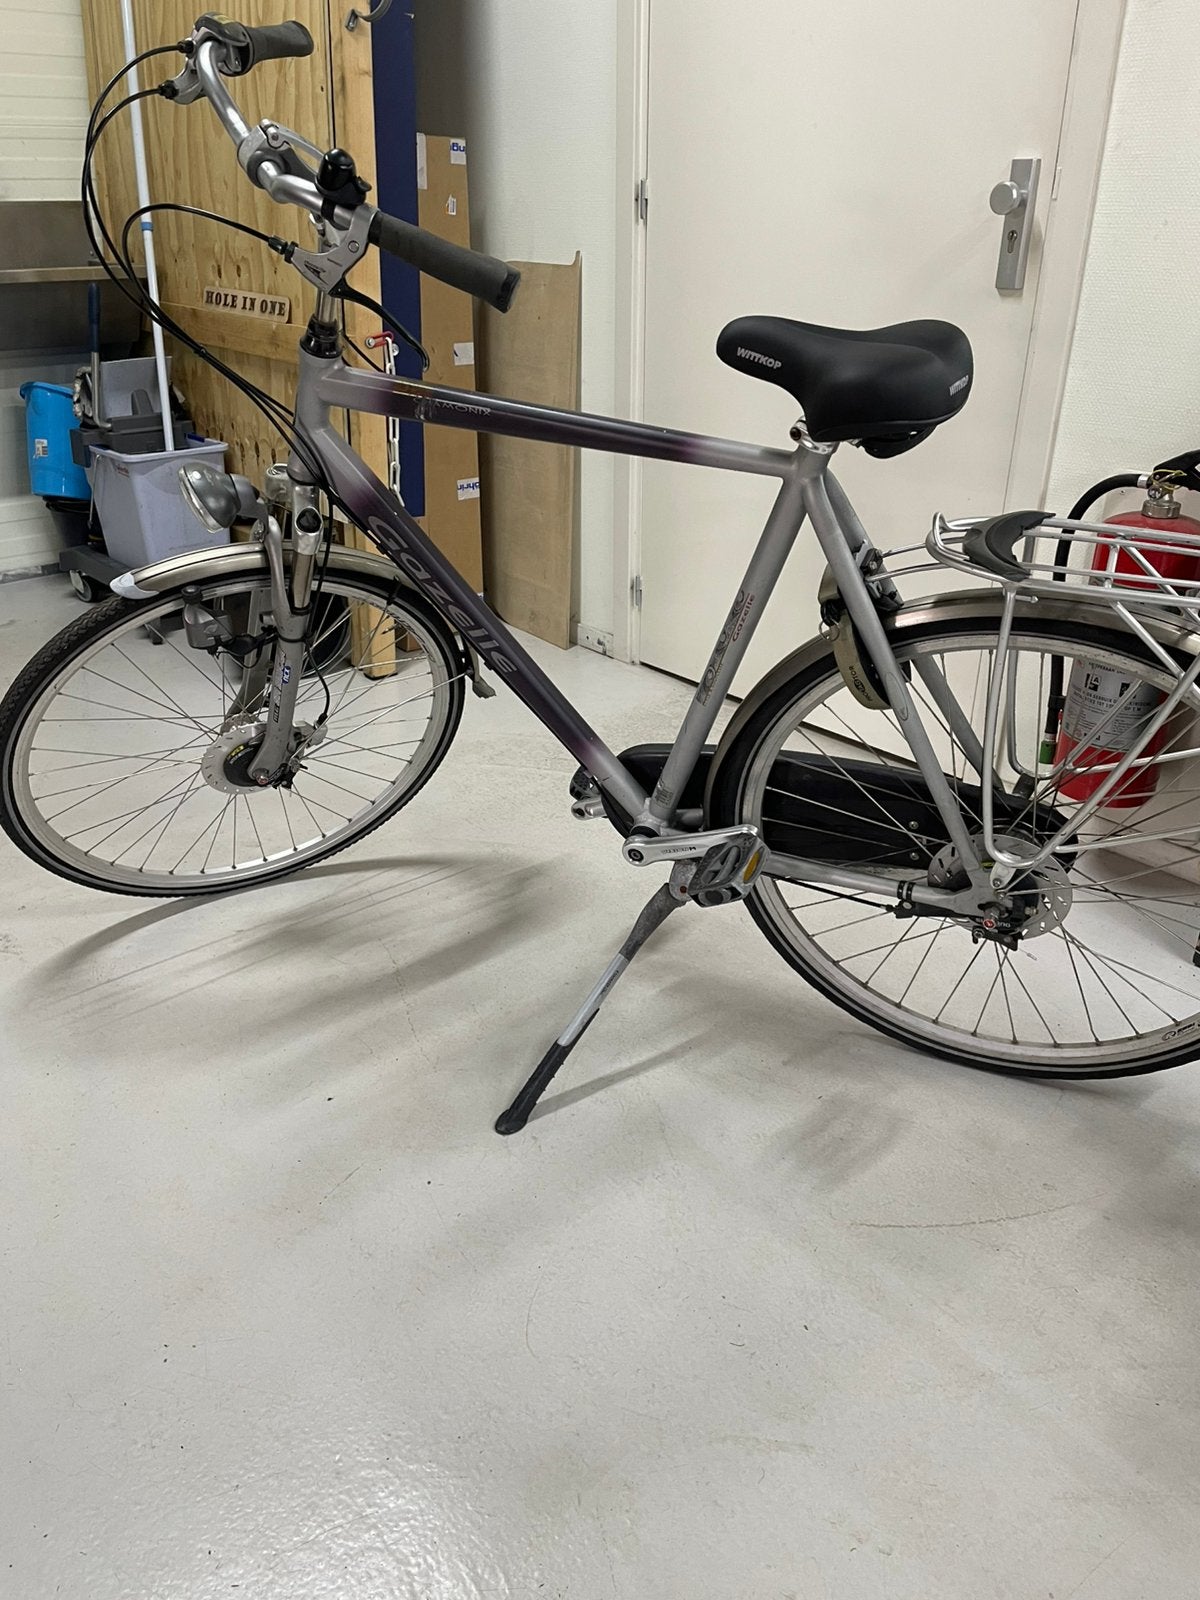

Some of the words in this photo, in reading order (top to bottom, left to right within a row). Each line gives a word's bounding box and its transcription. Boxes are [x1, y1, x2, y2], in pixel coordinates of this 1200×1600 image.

[205, 290, 238, 309] HOLE
[241, 296, 256, 311] IN
[260, 299, 286, 317] ONE
[737, 346, 782, 369] WITTKOP
[368, 515, 518, 674] Gazelle
[732, 594, 756, 642] Gazelle
